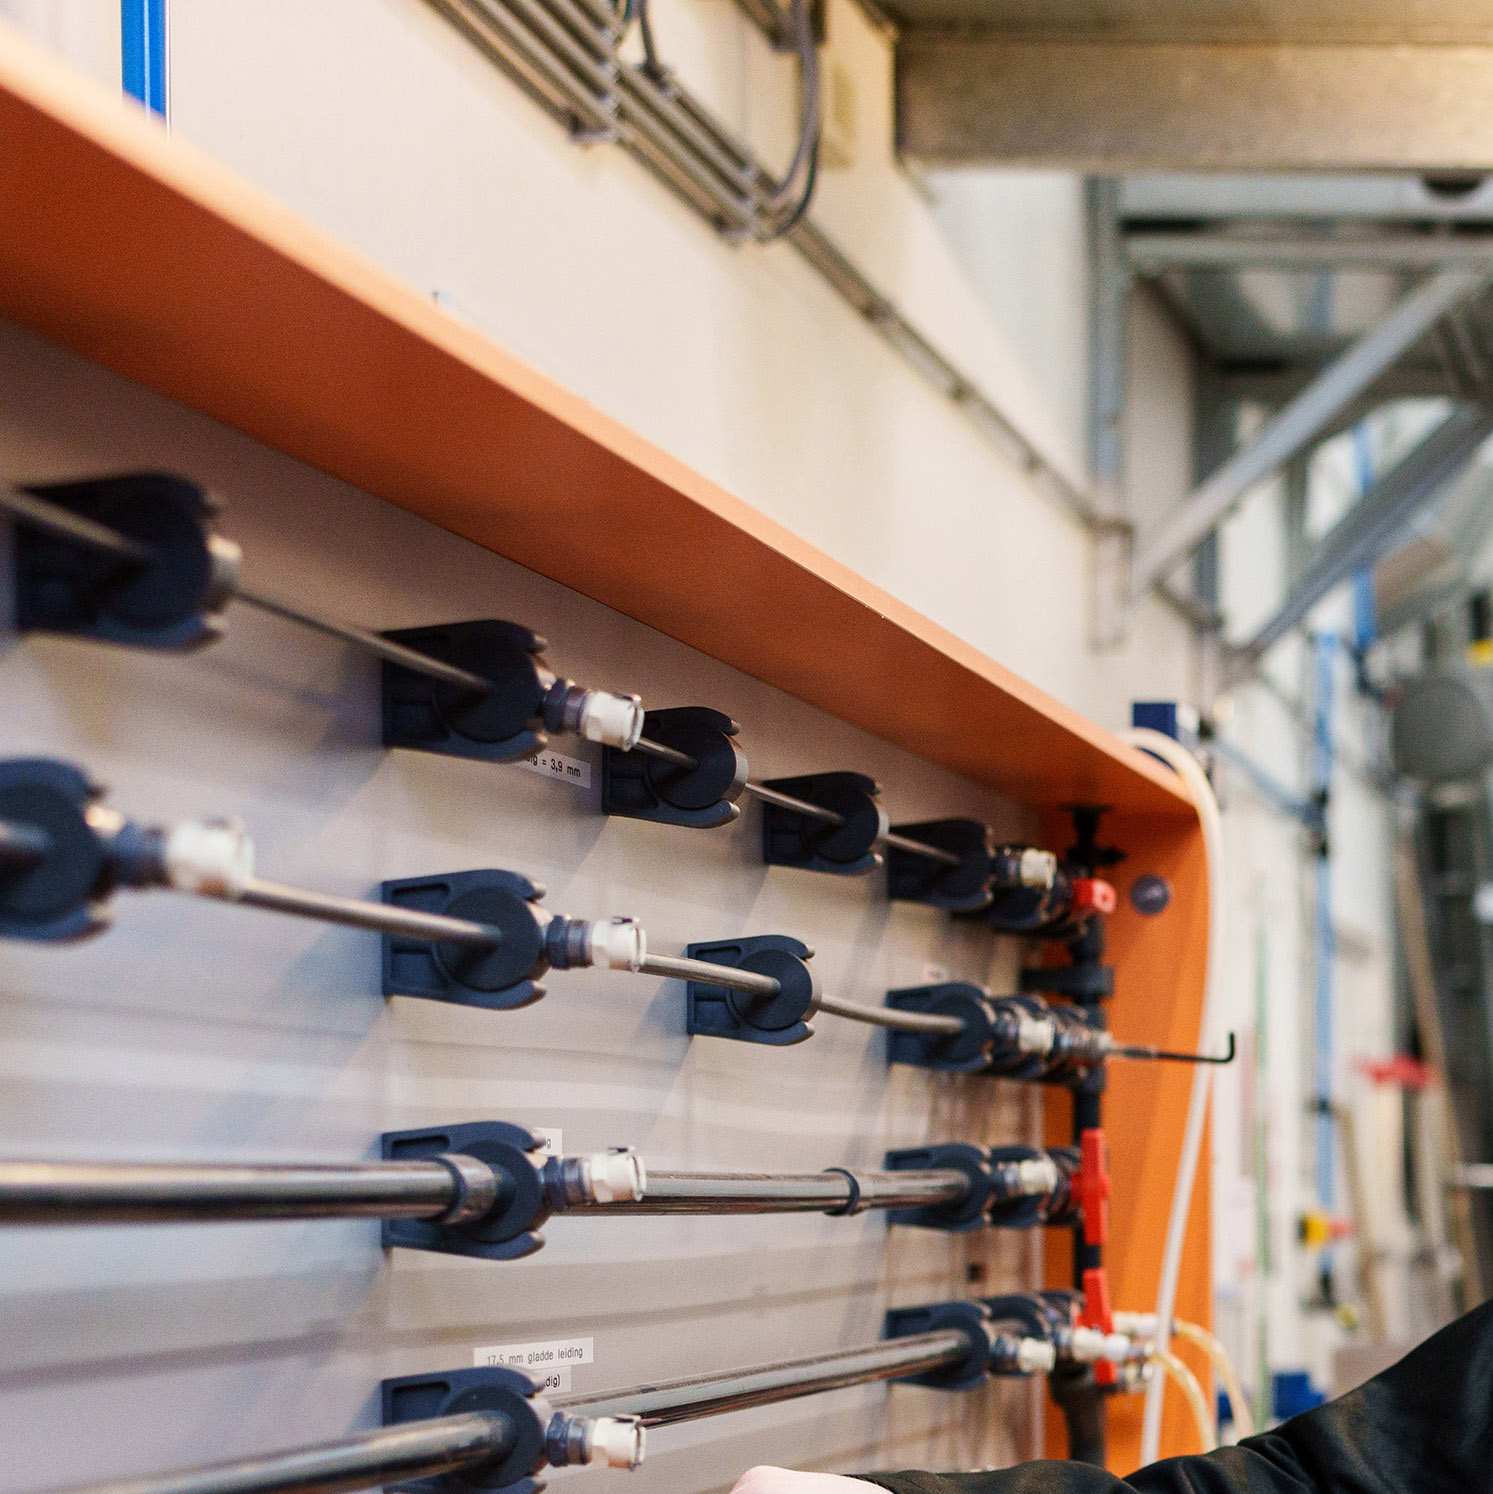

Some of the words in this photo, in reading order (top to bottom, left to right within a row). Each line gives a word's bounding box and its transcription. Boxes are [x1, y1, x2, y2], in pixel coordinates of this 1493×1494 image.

[551, 758, 563, 772] 3,9
[567, 765, 581, 778] mm
[509, 1354, 523, 1365] mm
[528, 1350, 554, 1364] gladde
[558, 1347, 583, 1359] leiding
